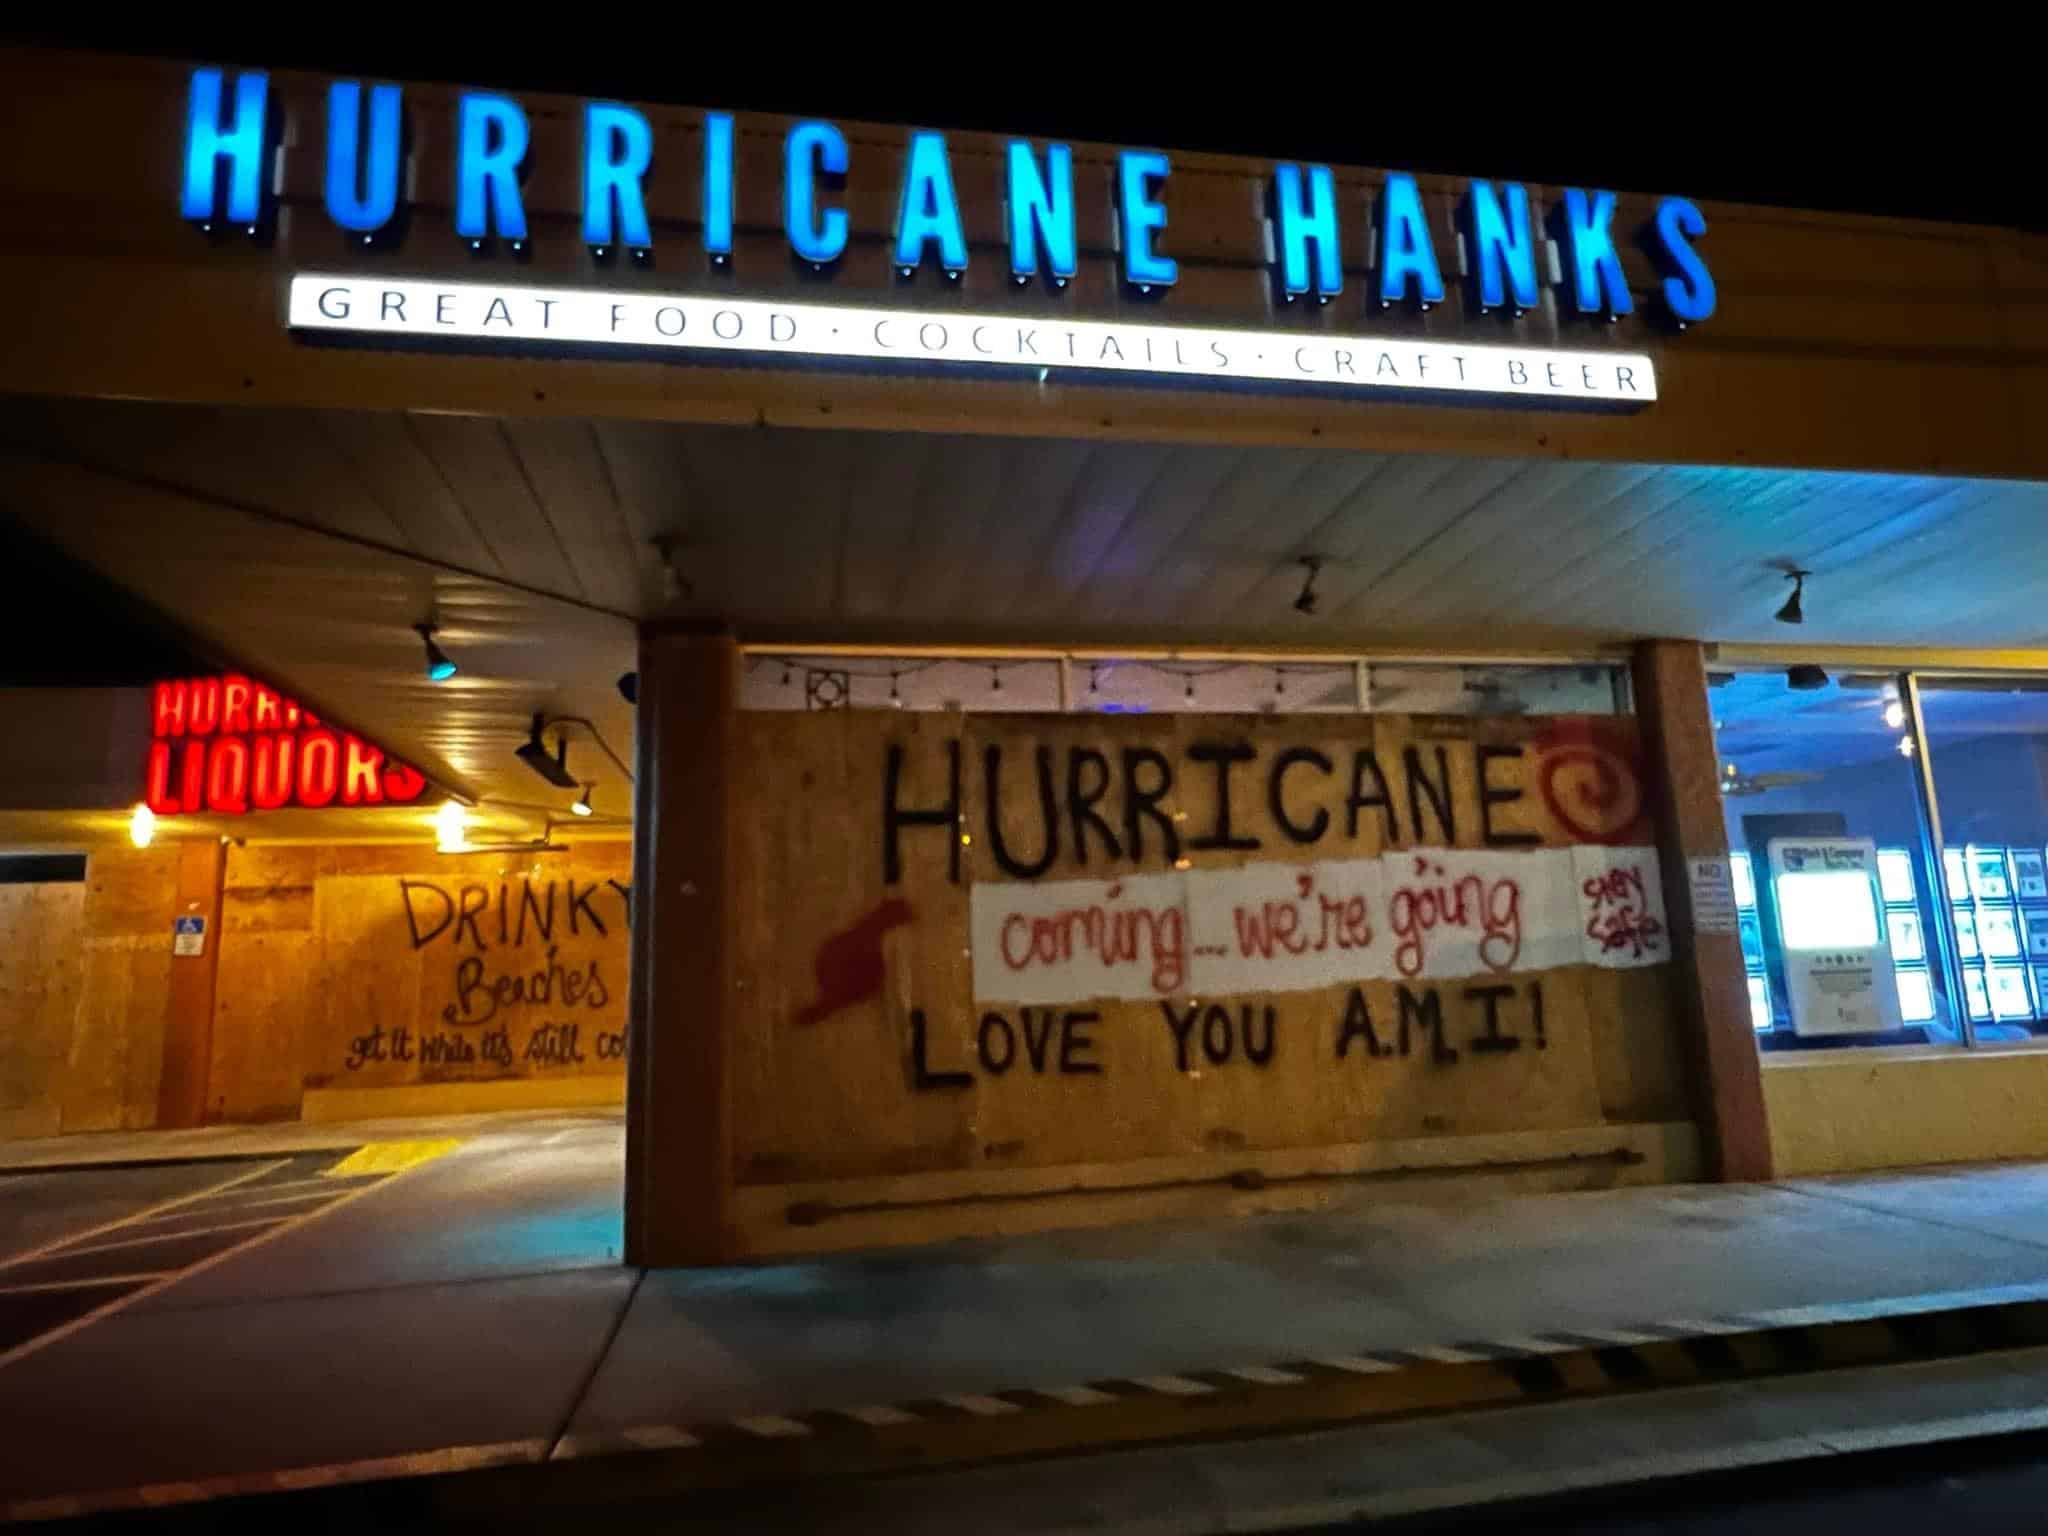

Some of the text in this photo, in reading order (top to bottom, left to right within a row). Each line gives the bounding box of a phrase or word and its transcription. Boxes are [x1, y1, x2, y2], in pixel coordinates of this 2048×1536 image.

[180, 69, 1716, 322] HURRICANE HANKS
[317, 286, 1638, 393] GREAT FOOD COCKTAILS CRAFT BEER
[153, 674, 322, 738] HURR
[885, 738, 1544, 884] HURRICANE
[1232, 874, 1373, 960] we're
[1390, 856, 1522, 979] going
[442, 945, 609, 1027] Beaches
[909, 1004, 1104, 1091] LOVE
[1160, 1002, 1277, 1074] YOU
